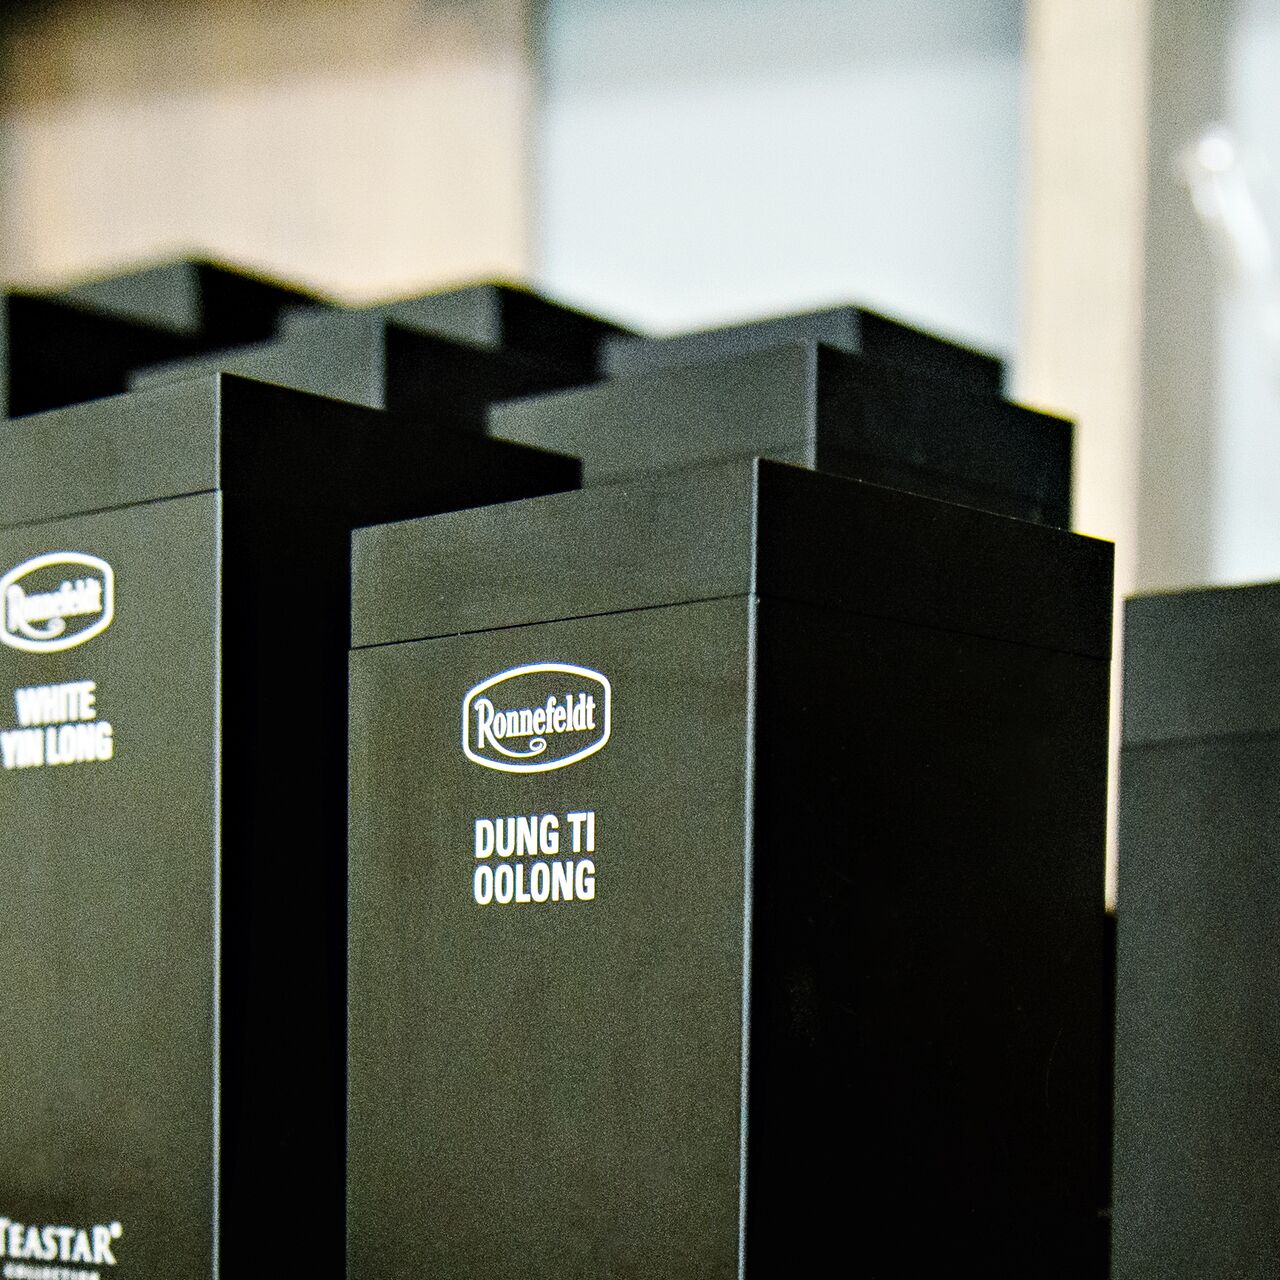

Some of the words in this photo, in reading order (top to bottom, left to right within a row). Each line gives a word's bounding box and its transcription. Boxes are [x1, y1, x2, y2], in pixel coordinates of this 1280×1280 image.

[14, 679, 96, 726] WHITE
[474, 692, 596, 758] Ronnefeldt
[0, 726, 44, 769] YIN
[46, 721, 114, 766] LONG
[474, 814, 560, 860] DUNG
[567, 811, 596, 853] TI
[473, 859, 596, 905] OOLONG
